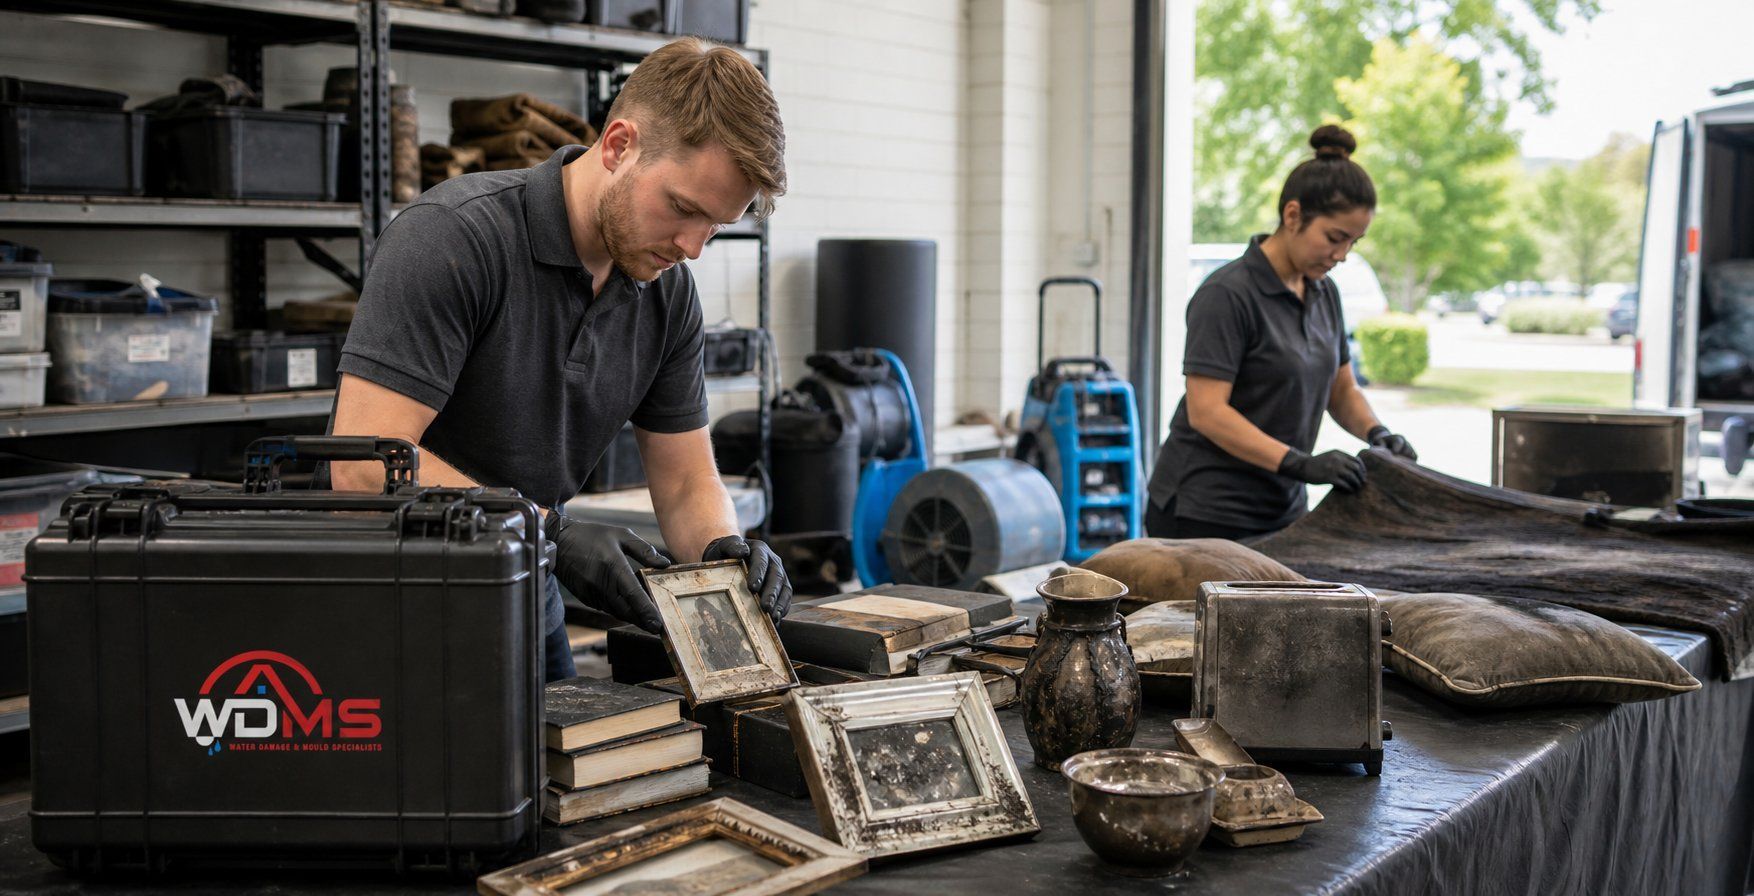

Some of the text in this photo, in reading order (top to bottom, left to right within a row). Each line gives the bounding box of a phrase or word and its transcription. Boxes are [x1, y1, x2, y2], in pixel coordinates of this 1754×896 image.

[173, 697, 383, 742] WDMS
[229, 743, 383, 751] WATER DAMAGE & MOULD SPECIALISTS
